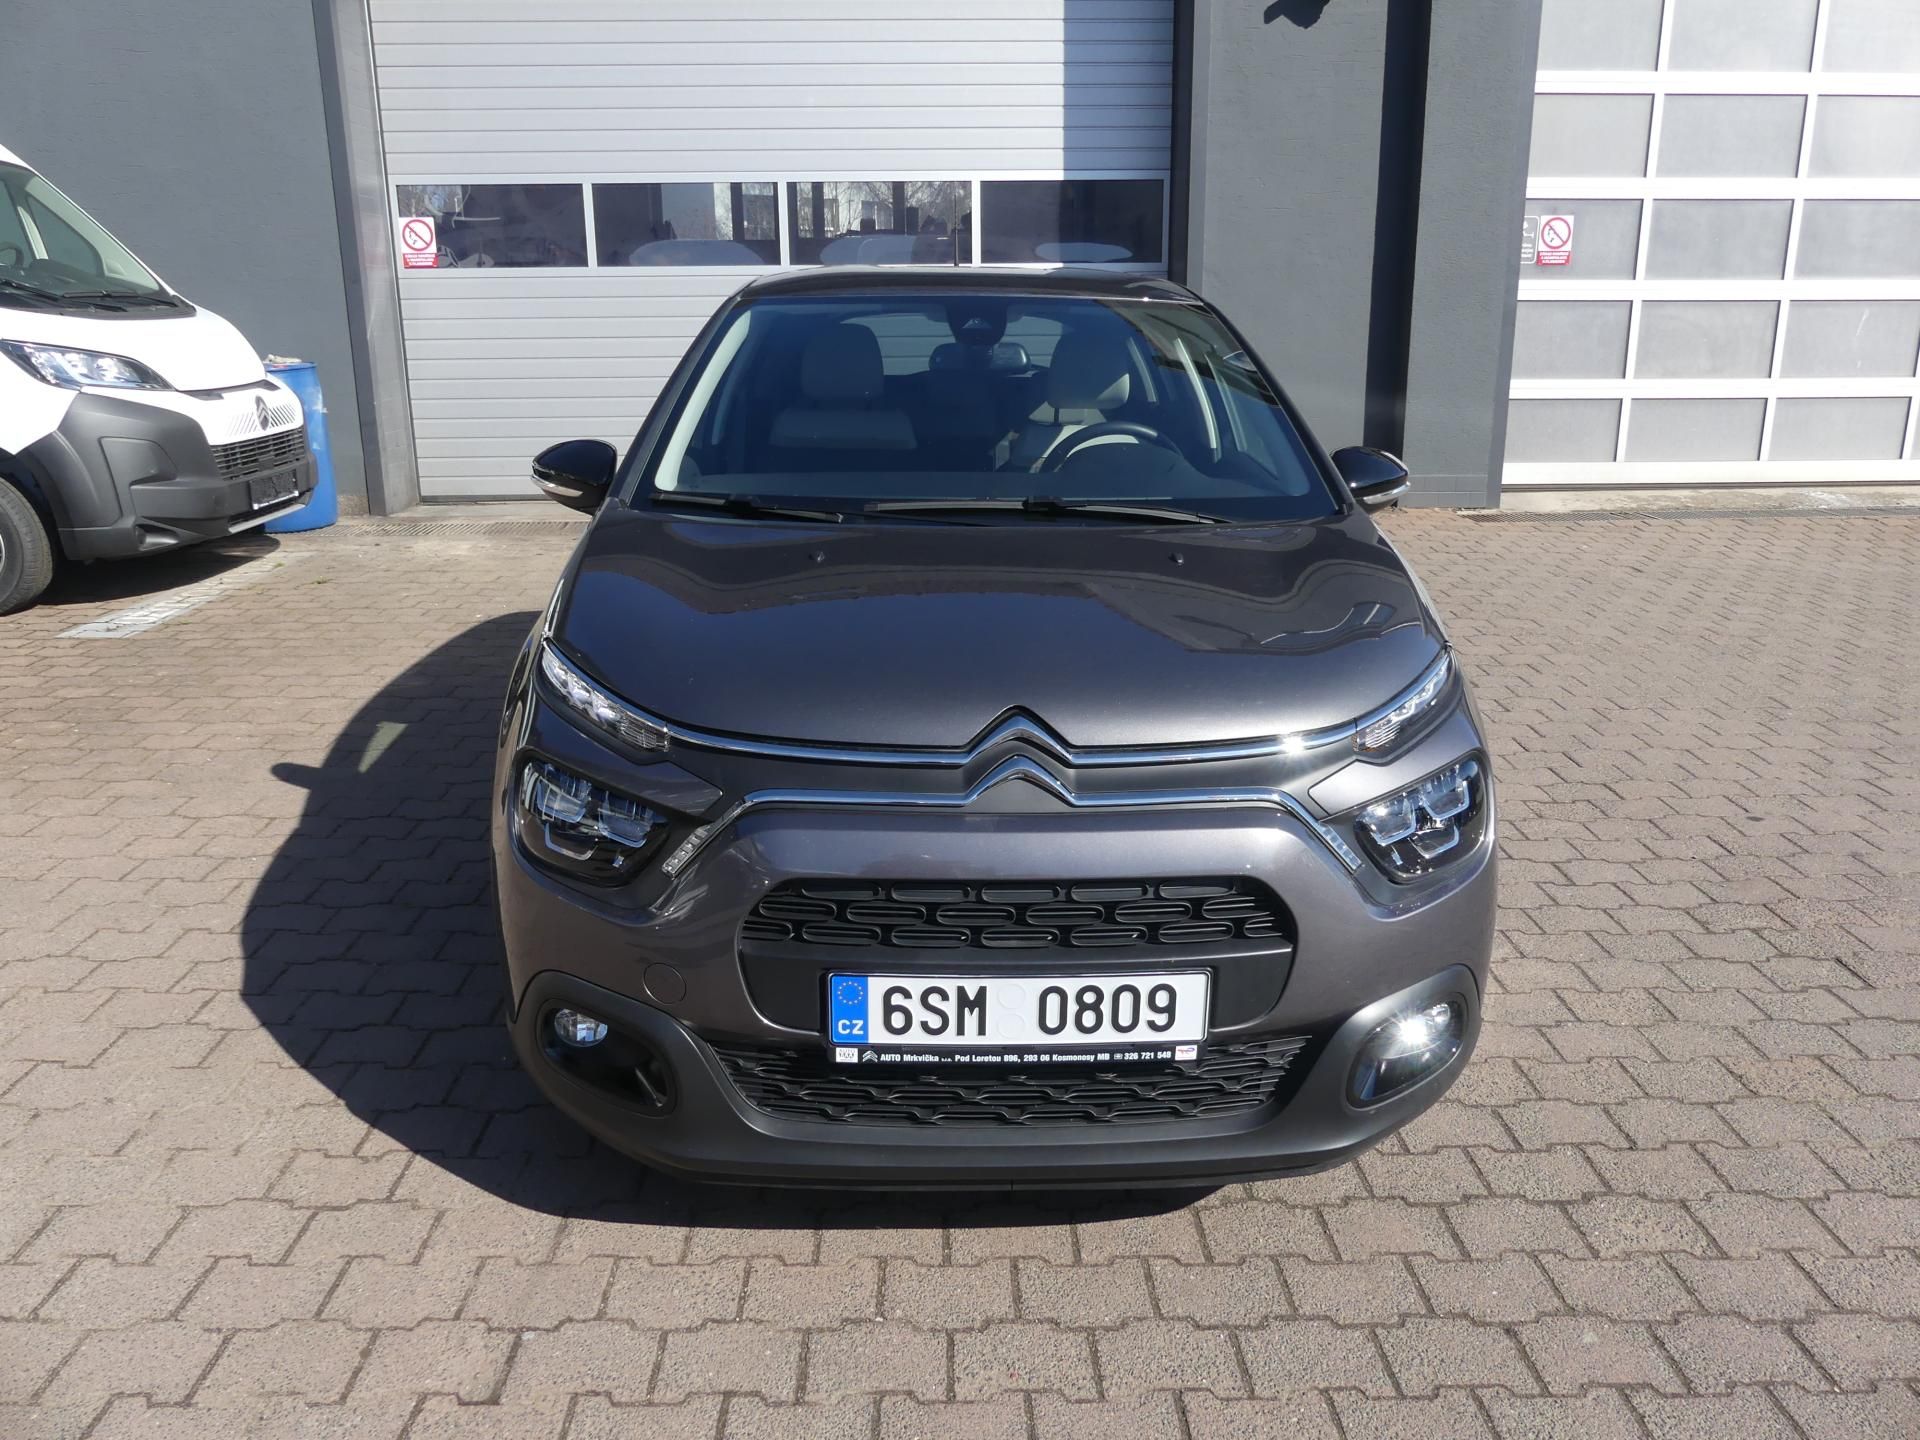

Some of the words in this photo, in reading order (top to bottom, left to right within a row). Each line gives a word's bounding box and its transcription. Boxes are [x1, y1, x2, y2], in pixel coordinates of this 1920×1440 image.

[882, 985, 988, 1037] 6SM
[1038, 983, 1178, 1035] 0809
[838, 1019, 864, 1035] CZ
[880, 1053, 901, 1062] AUTO
[903, 1053, 939, 1062] Mrkvička
[954, 1054, 970, 1062] Pod
[972, 1054, 1001, 1062] Loretou
[1023, 1054, 1038, 1062] 293
[1052, 1053, 1095, 1062] Kosmonosy
[1124, 1052, 1138, 1060] 326
[1141, 1051, 1154, 1060] 721
